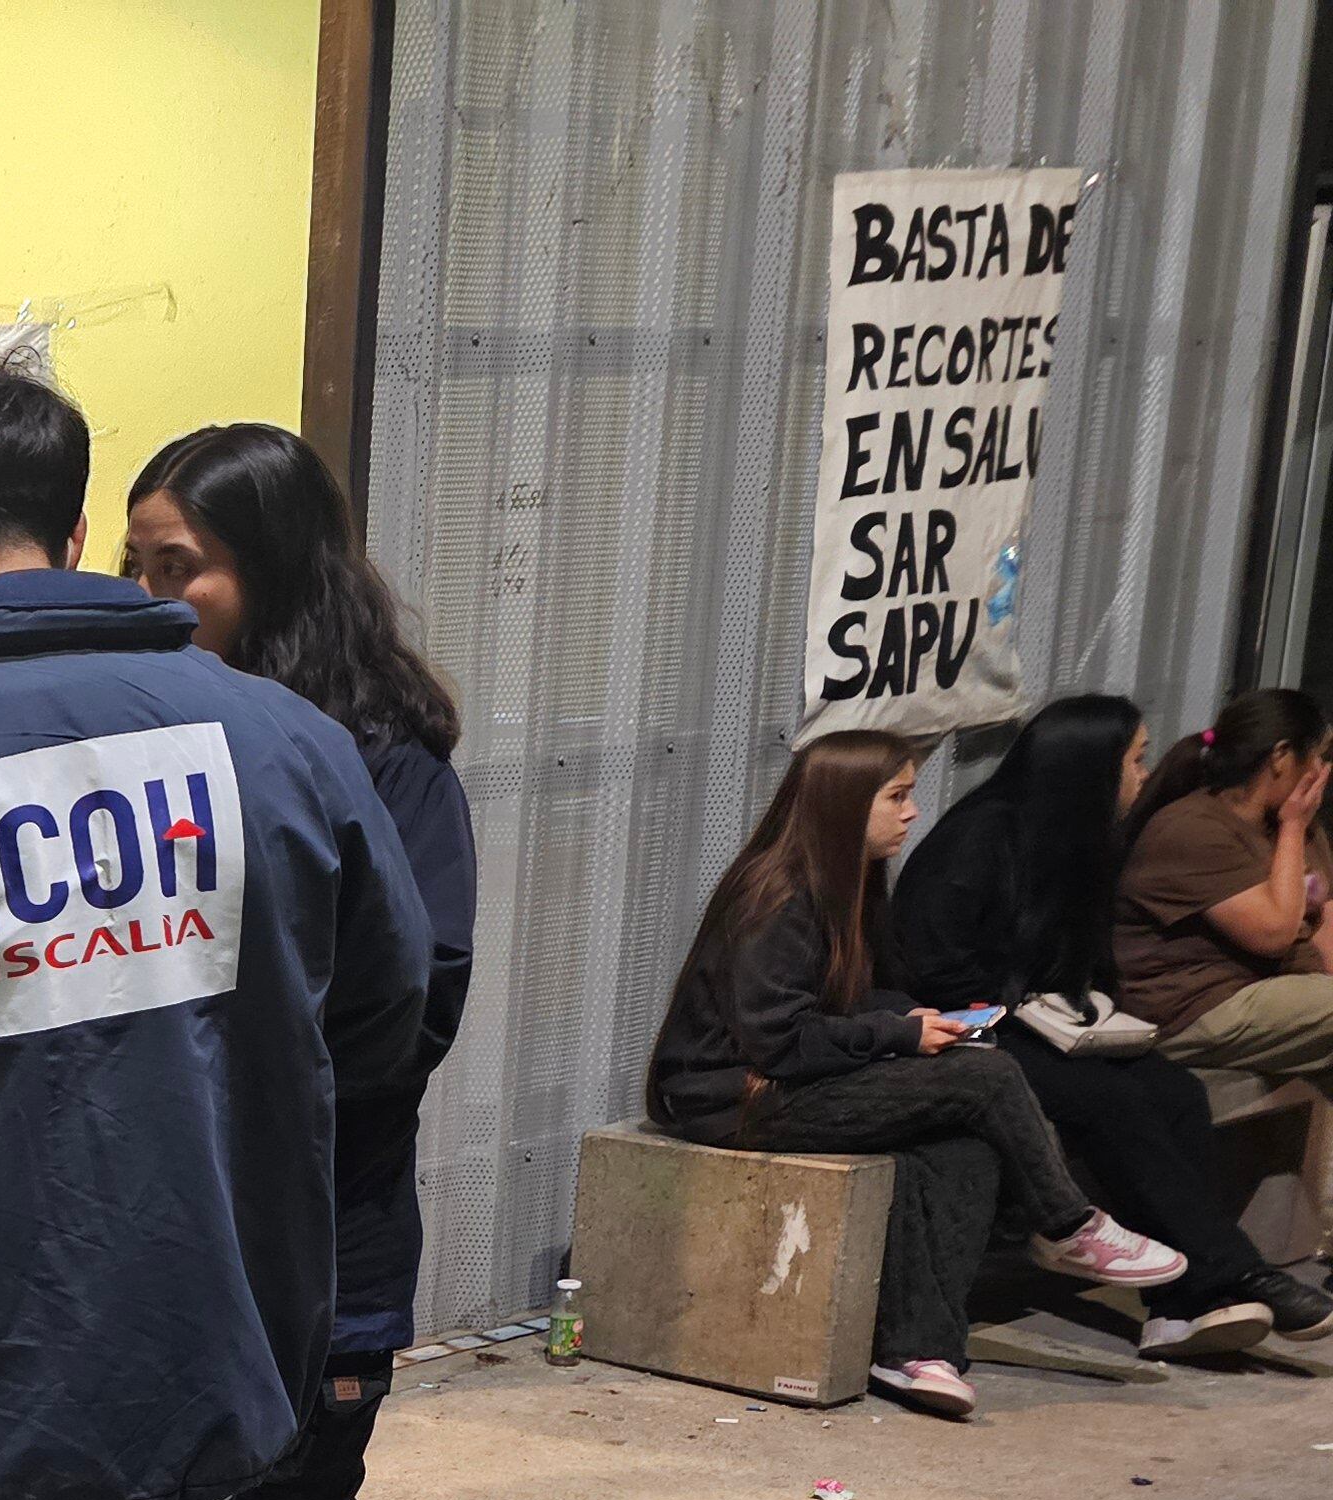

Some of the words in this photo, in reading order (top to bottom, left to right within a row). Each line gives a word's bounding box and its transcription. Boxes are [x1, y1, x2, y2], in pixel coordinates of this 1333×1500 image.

[847, 203, 1010, 287] BASTA
[1024, 203, 1077, 276] DE
[845, 315, 1060, 393] RECORTES
[839, 408, 934, 500] EN
[840, 509, 957, 601] SAR
[820, 597, 980, 700] SAPU
